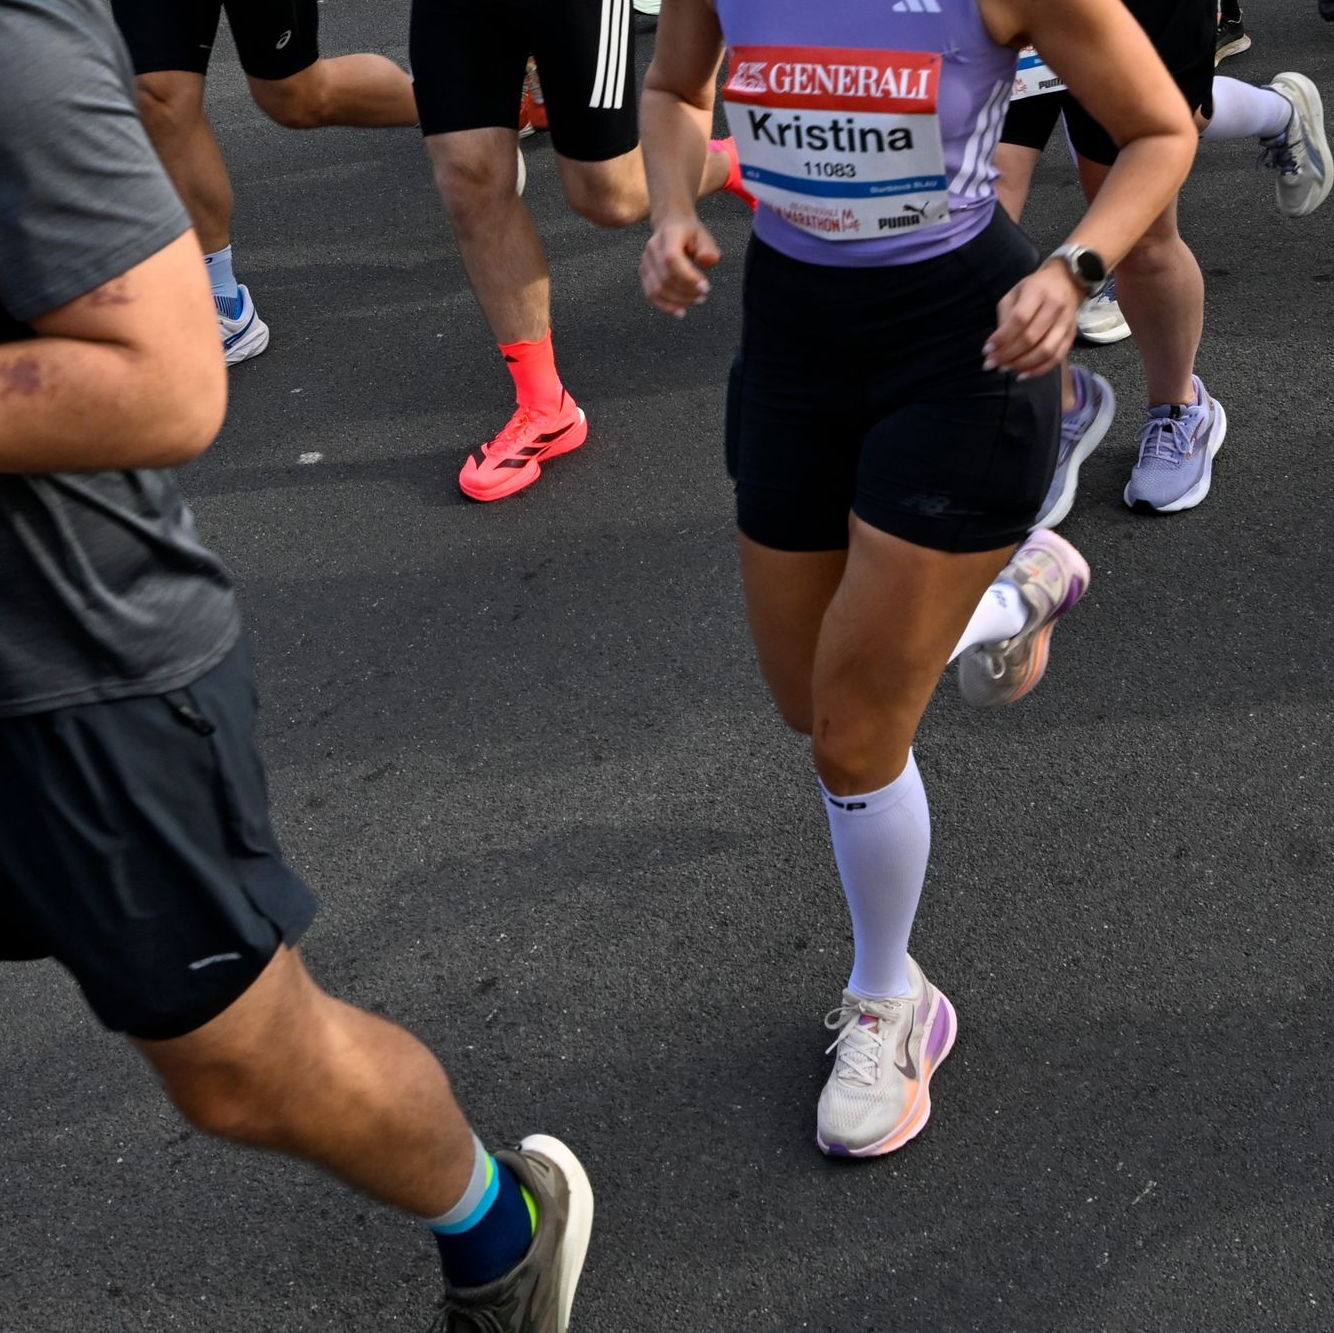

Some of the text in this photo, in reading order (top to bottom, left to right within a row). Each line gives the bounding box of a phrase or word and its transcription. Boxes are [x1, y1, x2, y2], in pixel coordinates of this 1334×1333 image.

[769, 61, 932, 100] GENERALI
[747, 109, 915, 153] Kristina
[804, 161, 857, 179] 11083
[878, 215, 921, 230] PUMA
